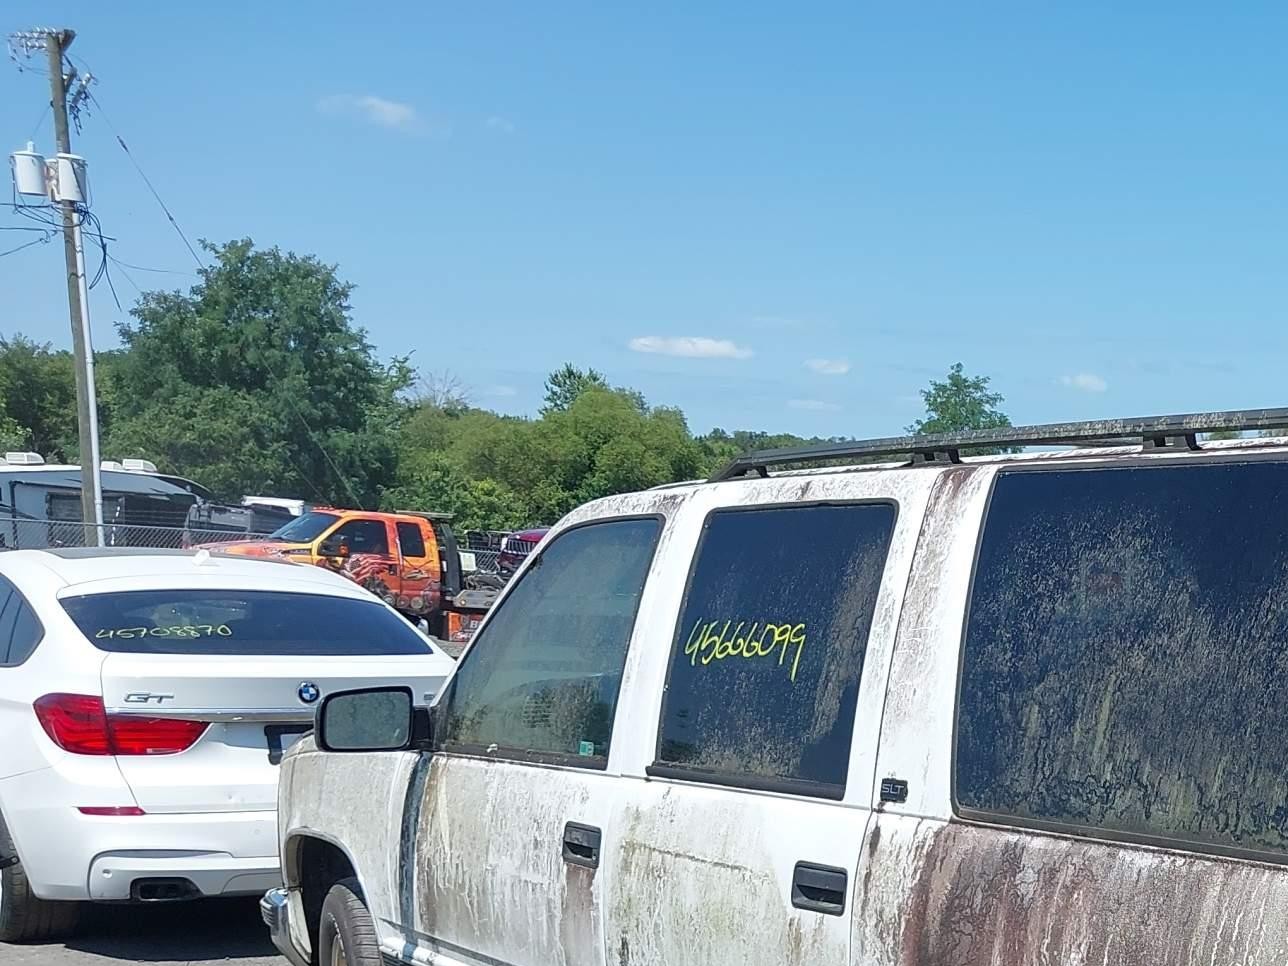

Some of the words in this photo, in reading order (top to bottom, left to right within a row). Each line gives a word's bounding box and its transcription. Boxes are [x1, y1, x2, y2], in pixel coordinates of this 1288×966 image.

[95, 624, 233, 639] 45708870
[684, 616, 806, 683] 45666099
[123, 692, 175, 704] GT
[881, 783, 905, 795] SLT
